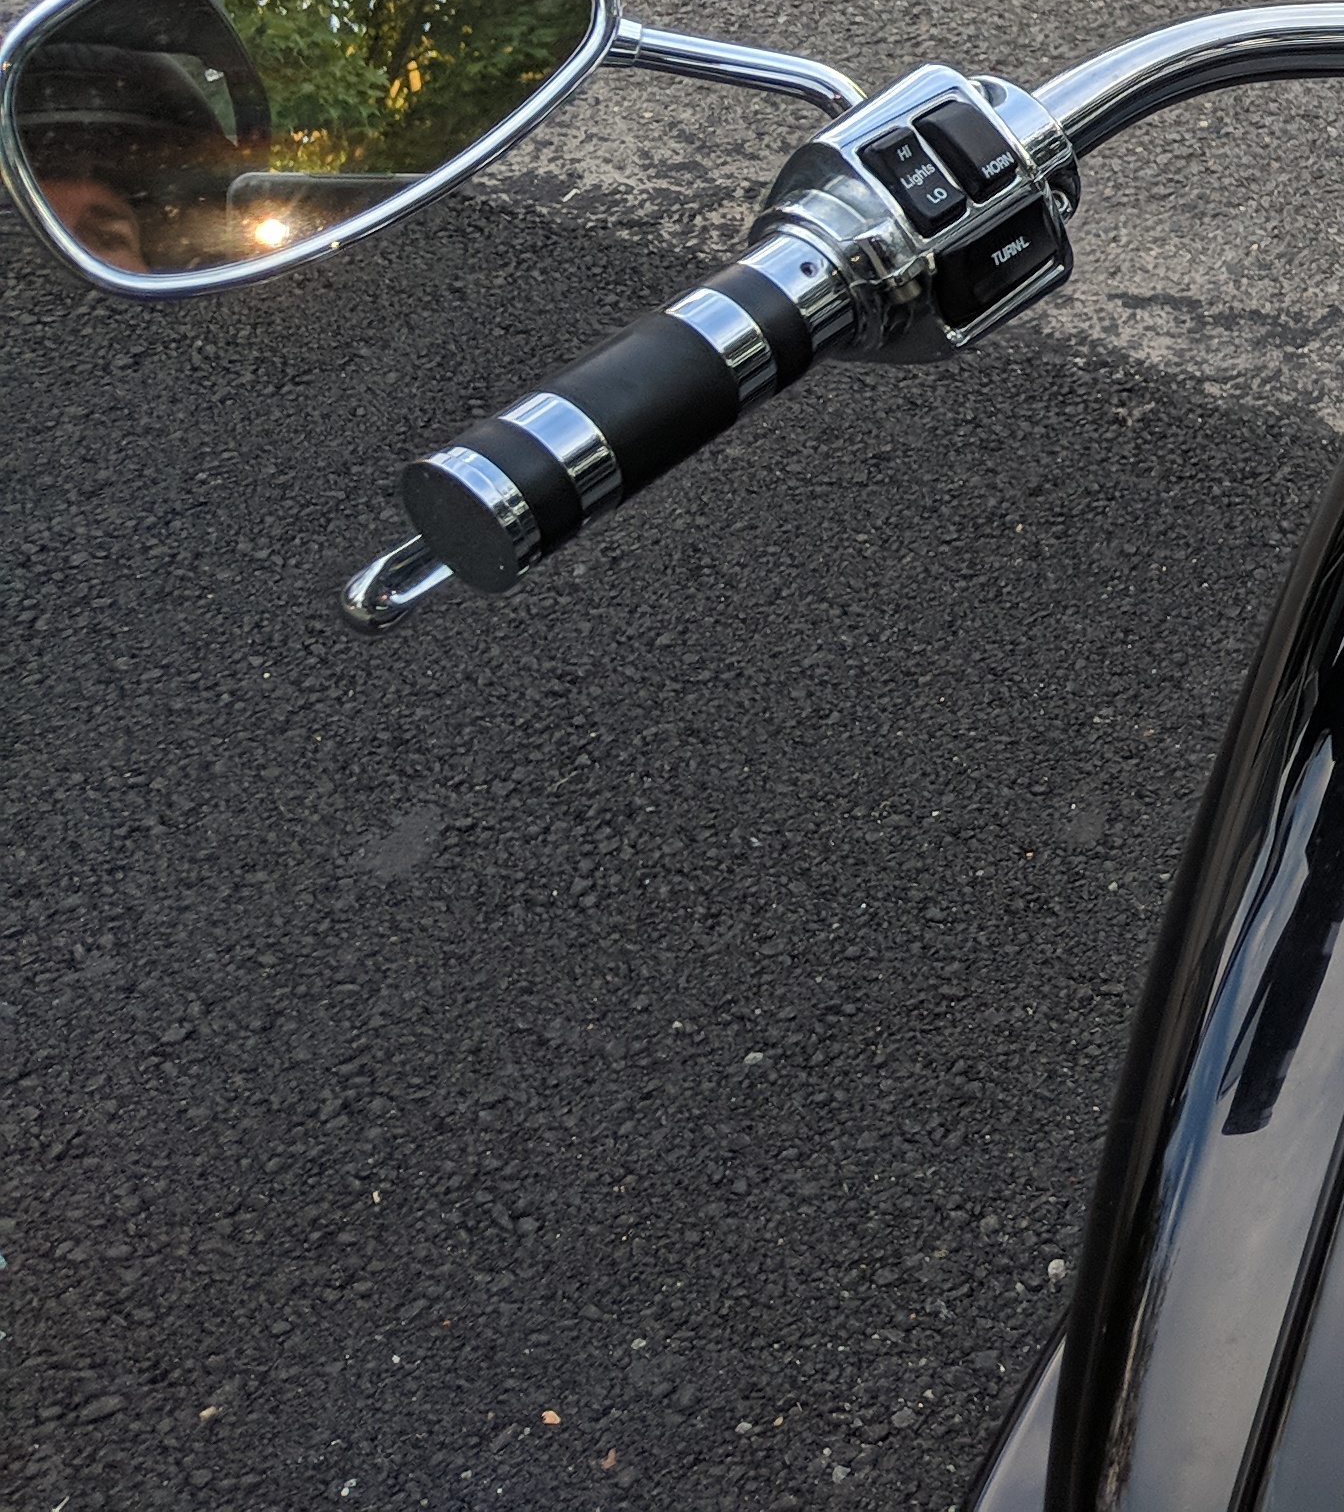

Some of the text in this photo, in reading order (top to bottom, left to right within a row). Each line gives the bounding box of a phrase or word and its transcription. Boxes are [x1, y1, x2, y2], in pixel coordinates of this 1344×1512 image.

[896, 144, 913, 162] HI
[981, 150, 1016, 179] HORN
[900, 162, 936, 190] Lights
[926, 187, 948, 204] LO
